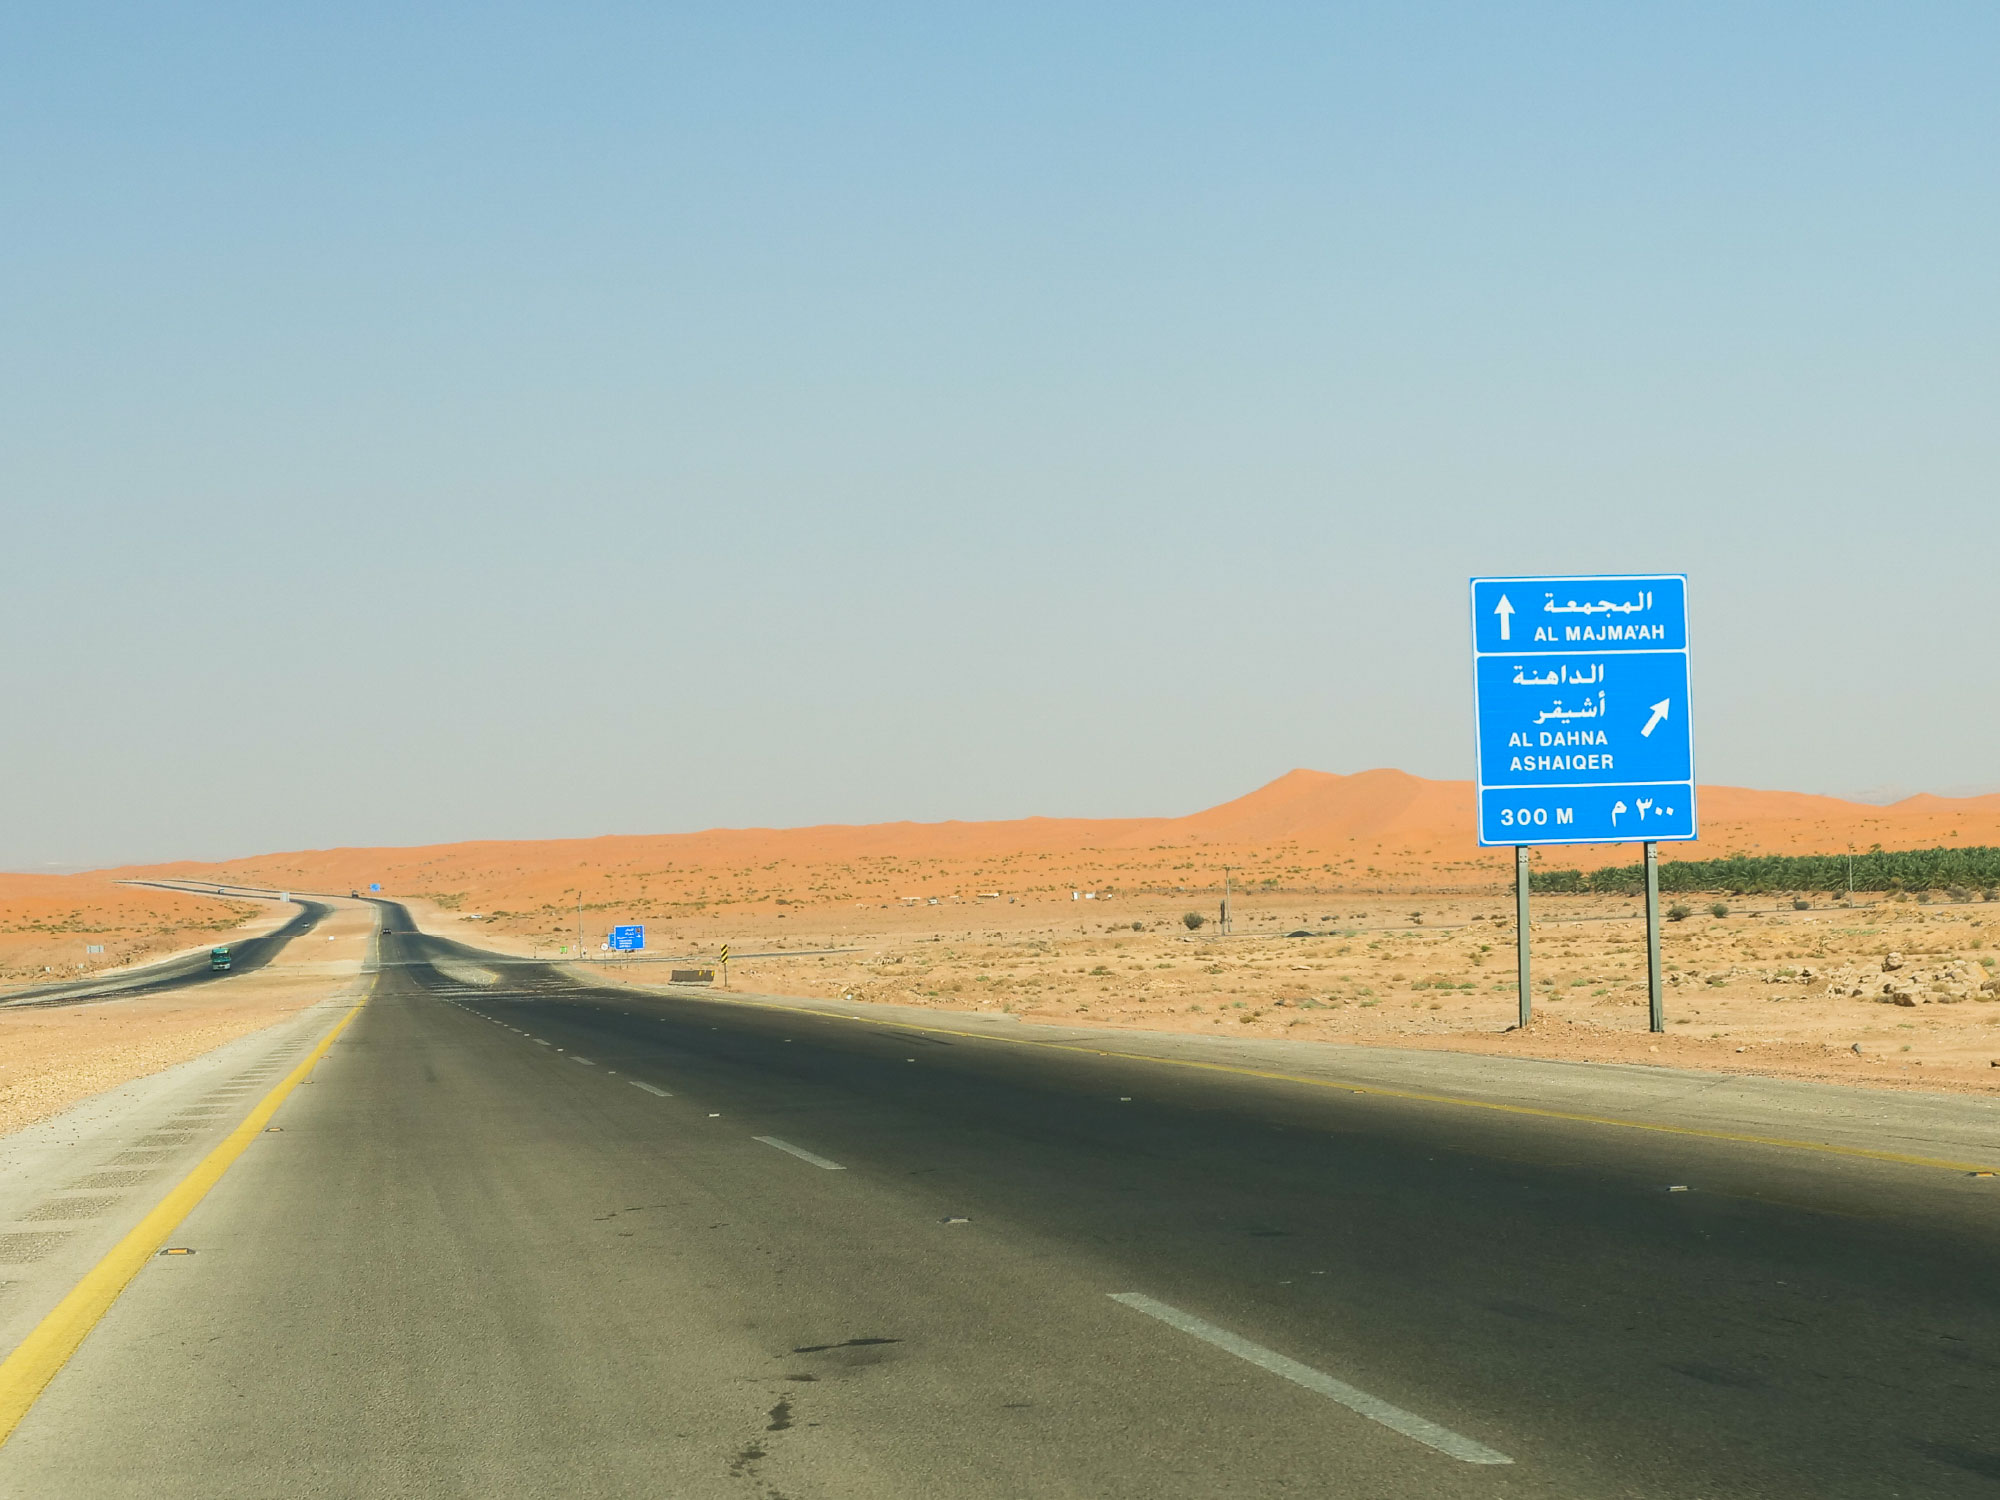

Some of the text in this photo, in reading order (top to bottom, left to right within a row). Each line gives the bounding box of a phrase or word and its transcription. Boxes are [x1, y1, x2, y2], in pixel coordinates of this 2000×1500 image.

[1543, 590, 1653, 619] المجمعة
[1534, 624, 1665, 642] AL MAJMA'AH
[1512, 663, 1604, 686] الداهنة
[1532, 690, 1606, 725] أشيقر
[1508, 730, 1608, 747] AL DAHNA
[1509, 753, 1614, 772] ASHAIQER
[1500, 807, 1574, 826] 300 M
[1611, 798, 1674, 828] ٣٠٠ م
